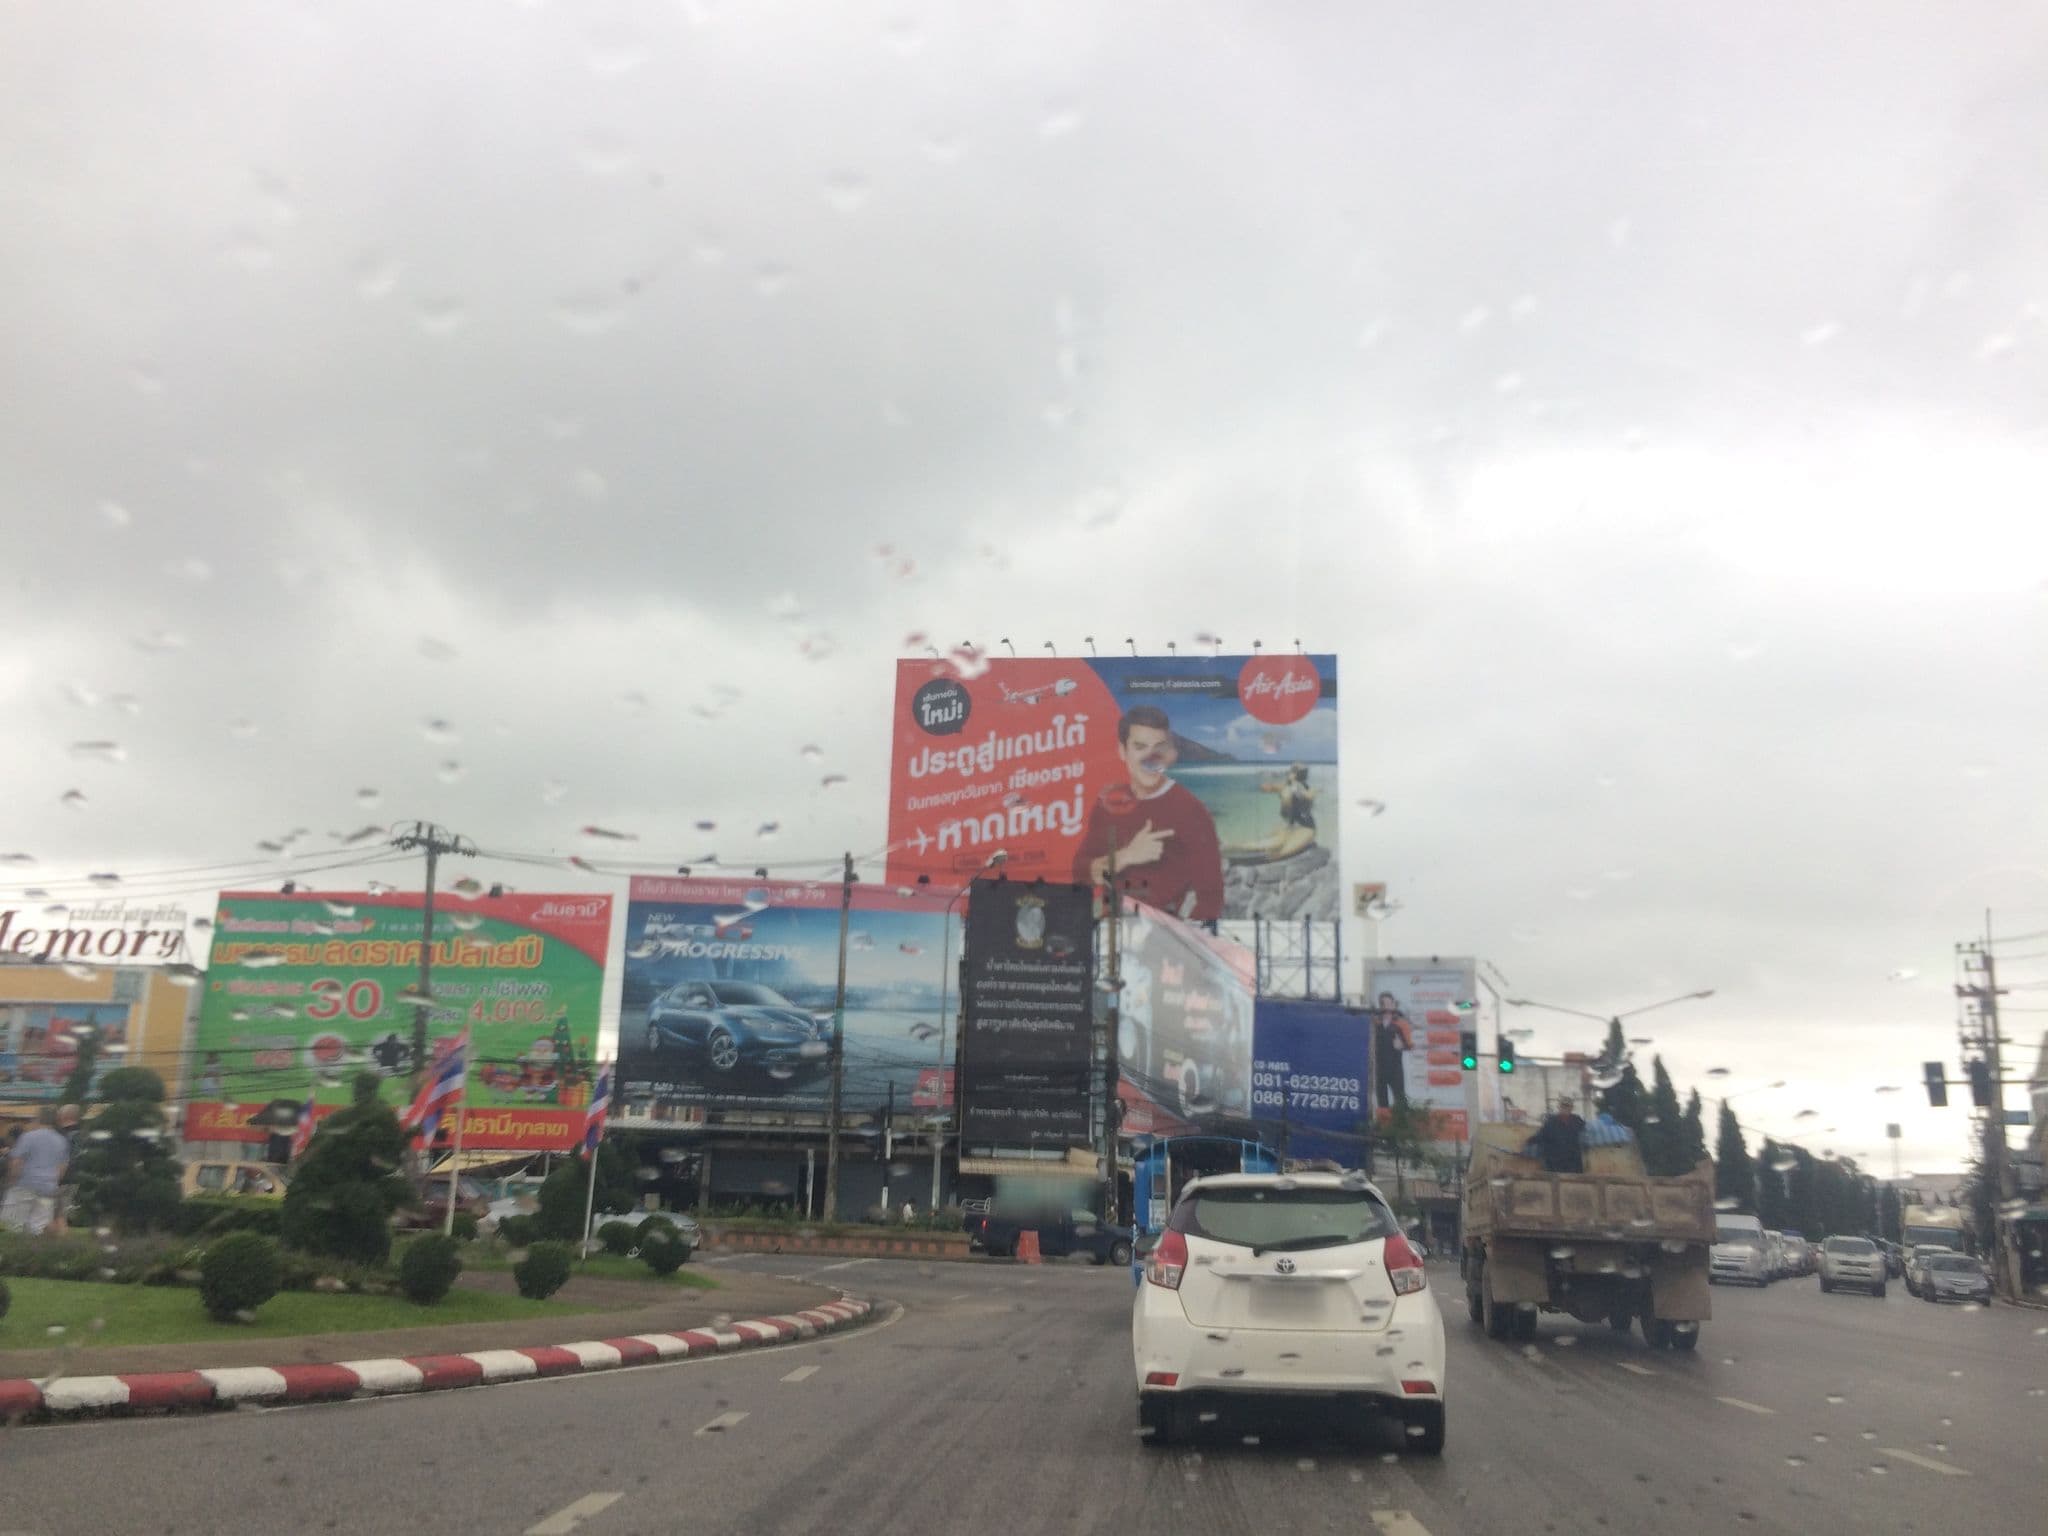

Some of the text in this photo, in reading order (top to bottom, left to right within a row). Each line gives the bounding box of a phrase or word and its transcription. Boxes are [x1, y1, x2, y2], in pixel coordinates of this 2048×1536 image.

[921, 699, 964, 727] ใหม่!
[910, 713, 1088, 778] ประตูสู่แดนใต้
[1008, 761, 1085, 790] เชียงราย
[307, 977, 382, 1020] 30
[1254, 1073, 1360, 1092] 081-6232203
[1254, 1090, 1360, 1110] 086-7726776
